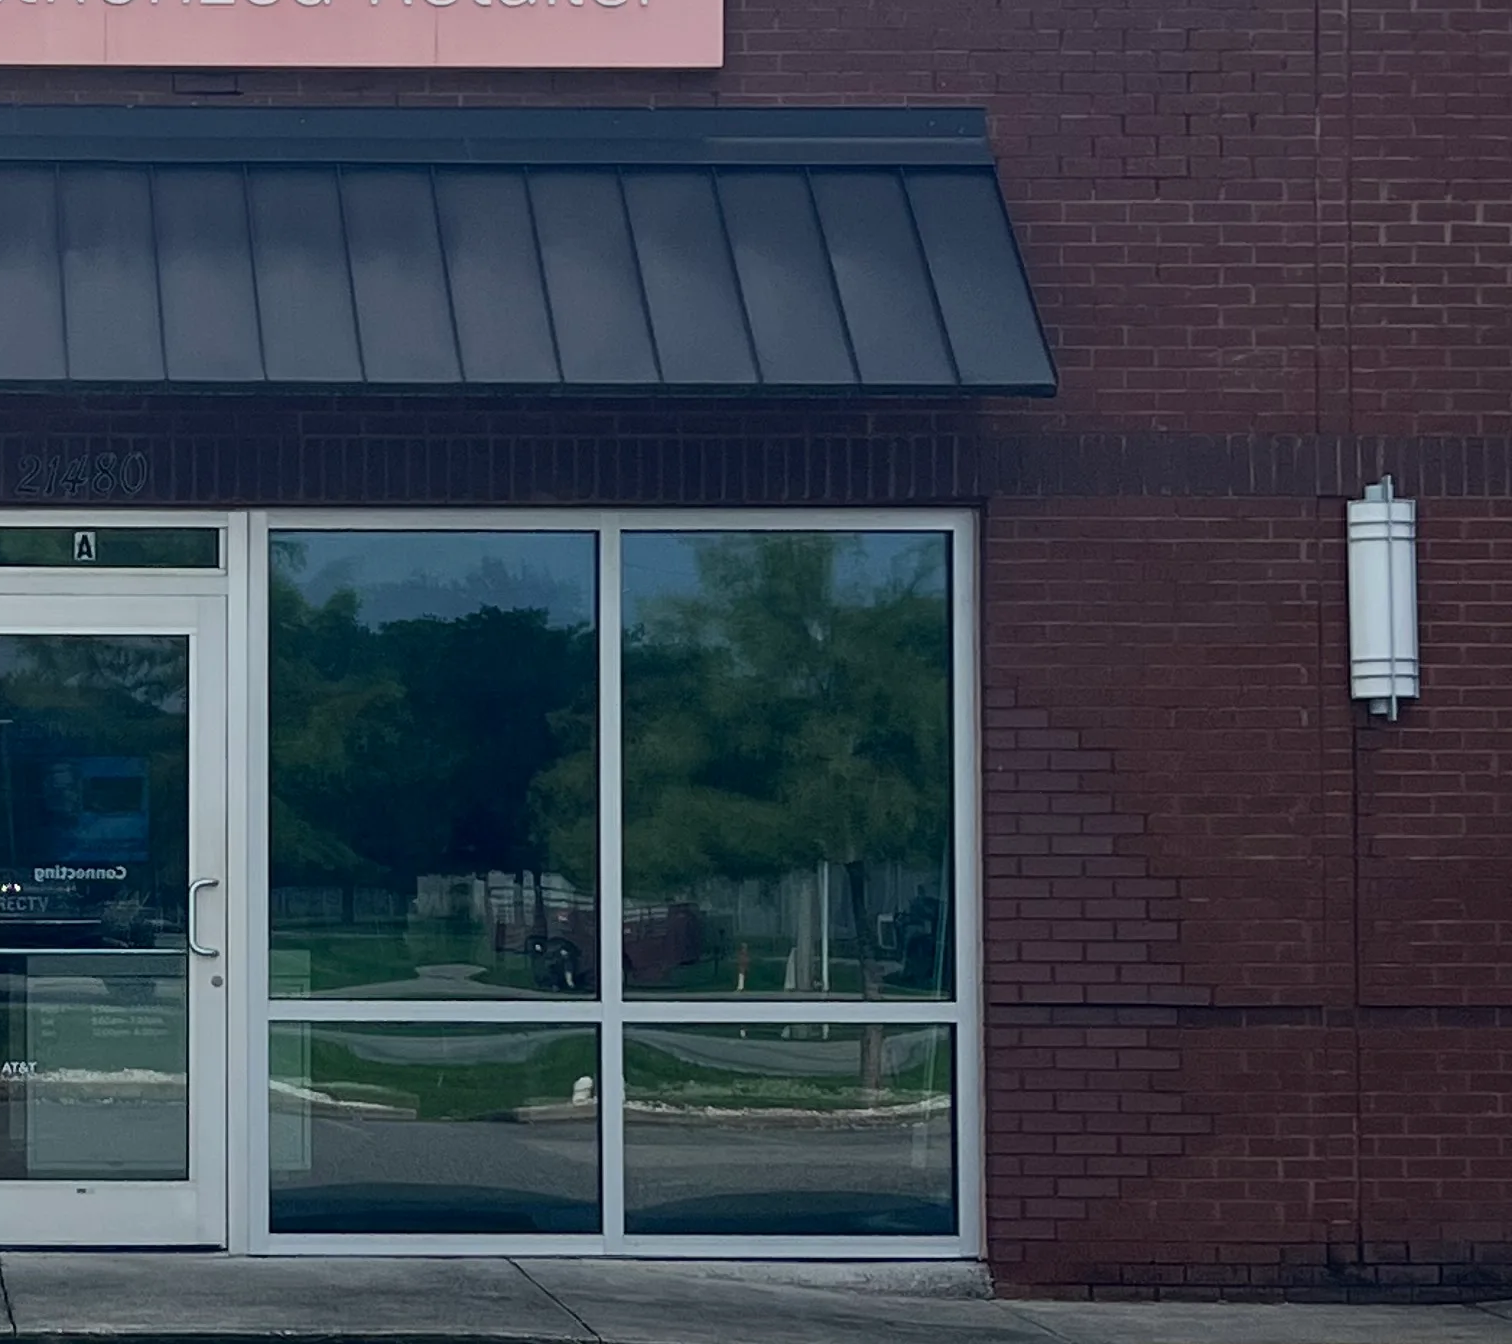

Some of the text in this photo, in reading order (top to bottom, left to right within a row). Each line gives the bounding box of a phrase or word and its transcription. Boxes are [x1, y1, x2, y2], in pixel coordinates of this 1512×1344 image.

[15, 451, 148, 497] 21480
[77, 534, 93, 560] A
[2, 1061, 37, 1075] AT&T
